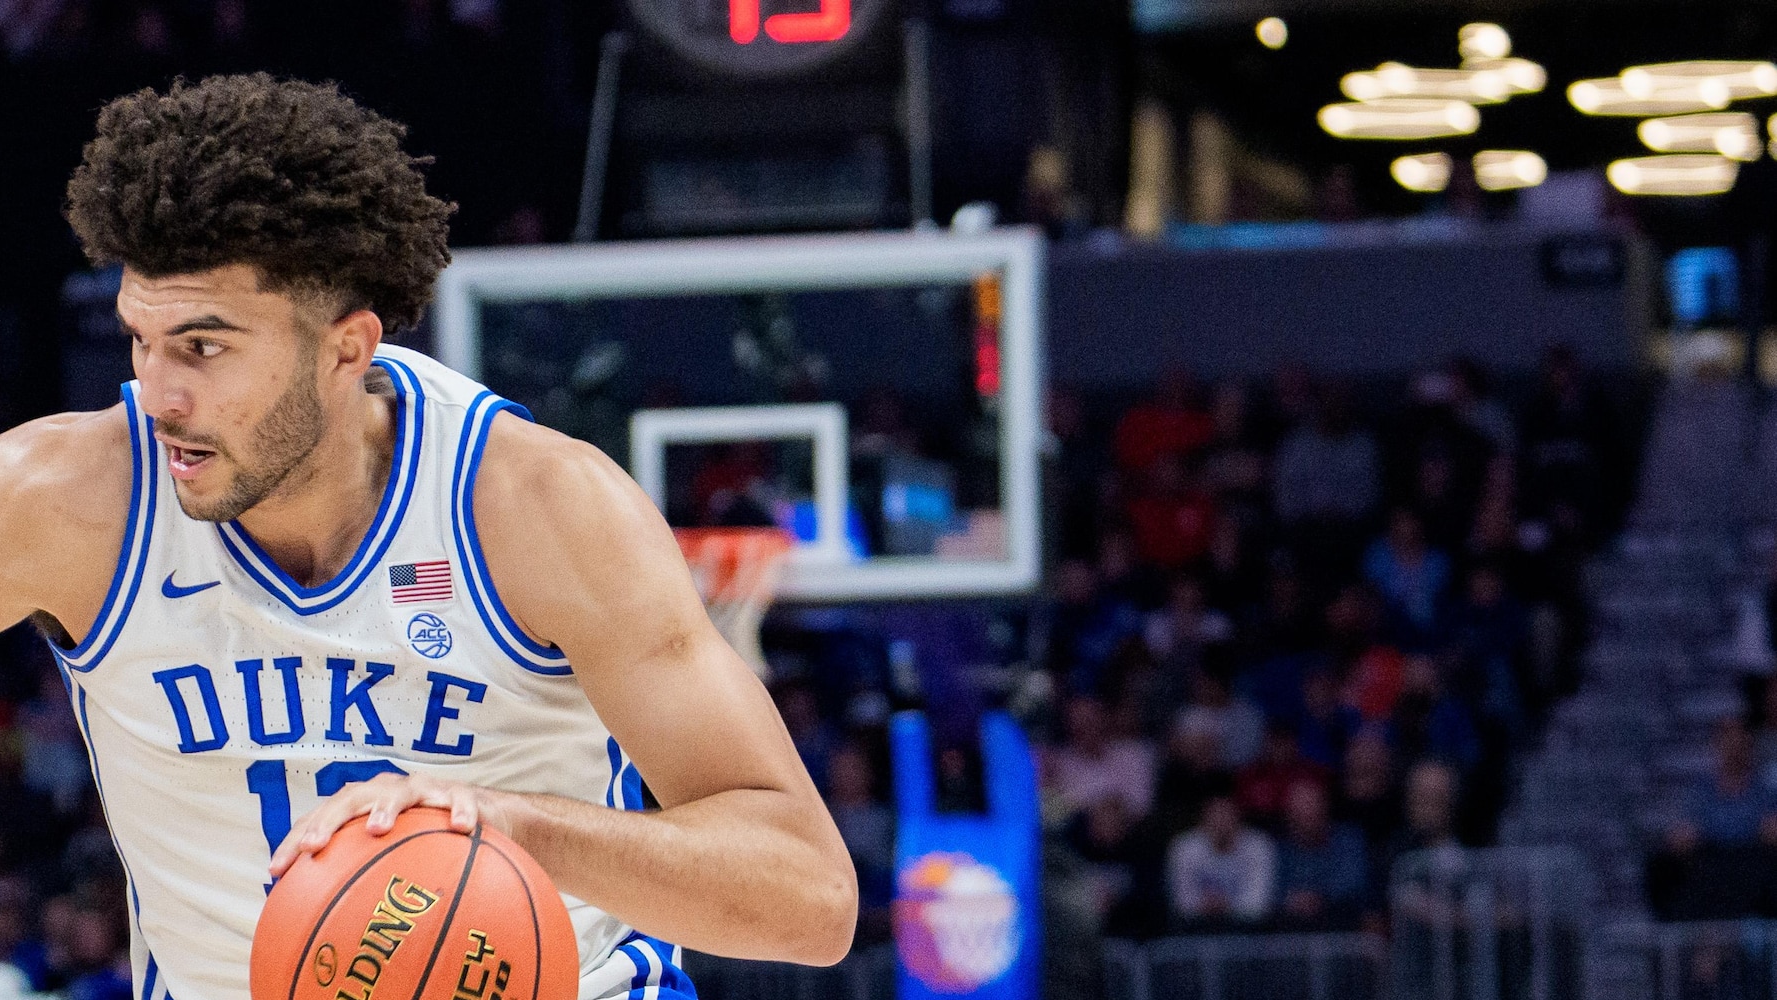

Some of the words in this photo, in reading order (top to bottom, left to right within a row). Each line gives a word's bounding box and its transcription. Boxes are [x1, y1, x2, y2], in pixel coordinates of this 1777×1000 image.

[414, 627, 448, 639] ACC
[152, 656, 488, 756] DUKE
[246, 759, 410, 898] 1
